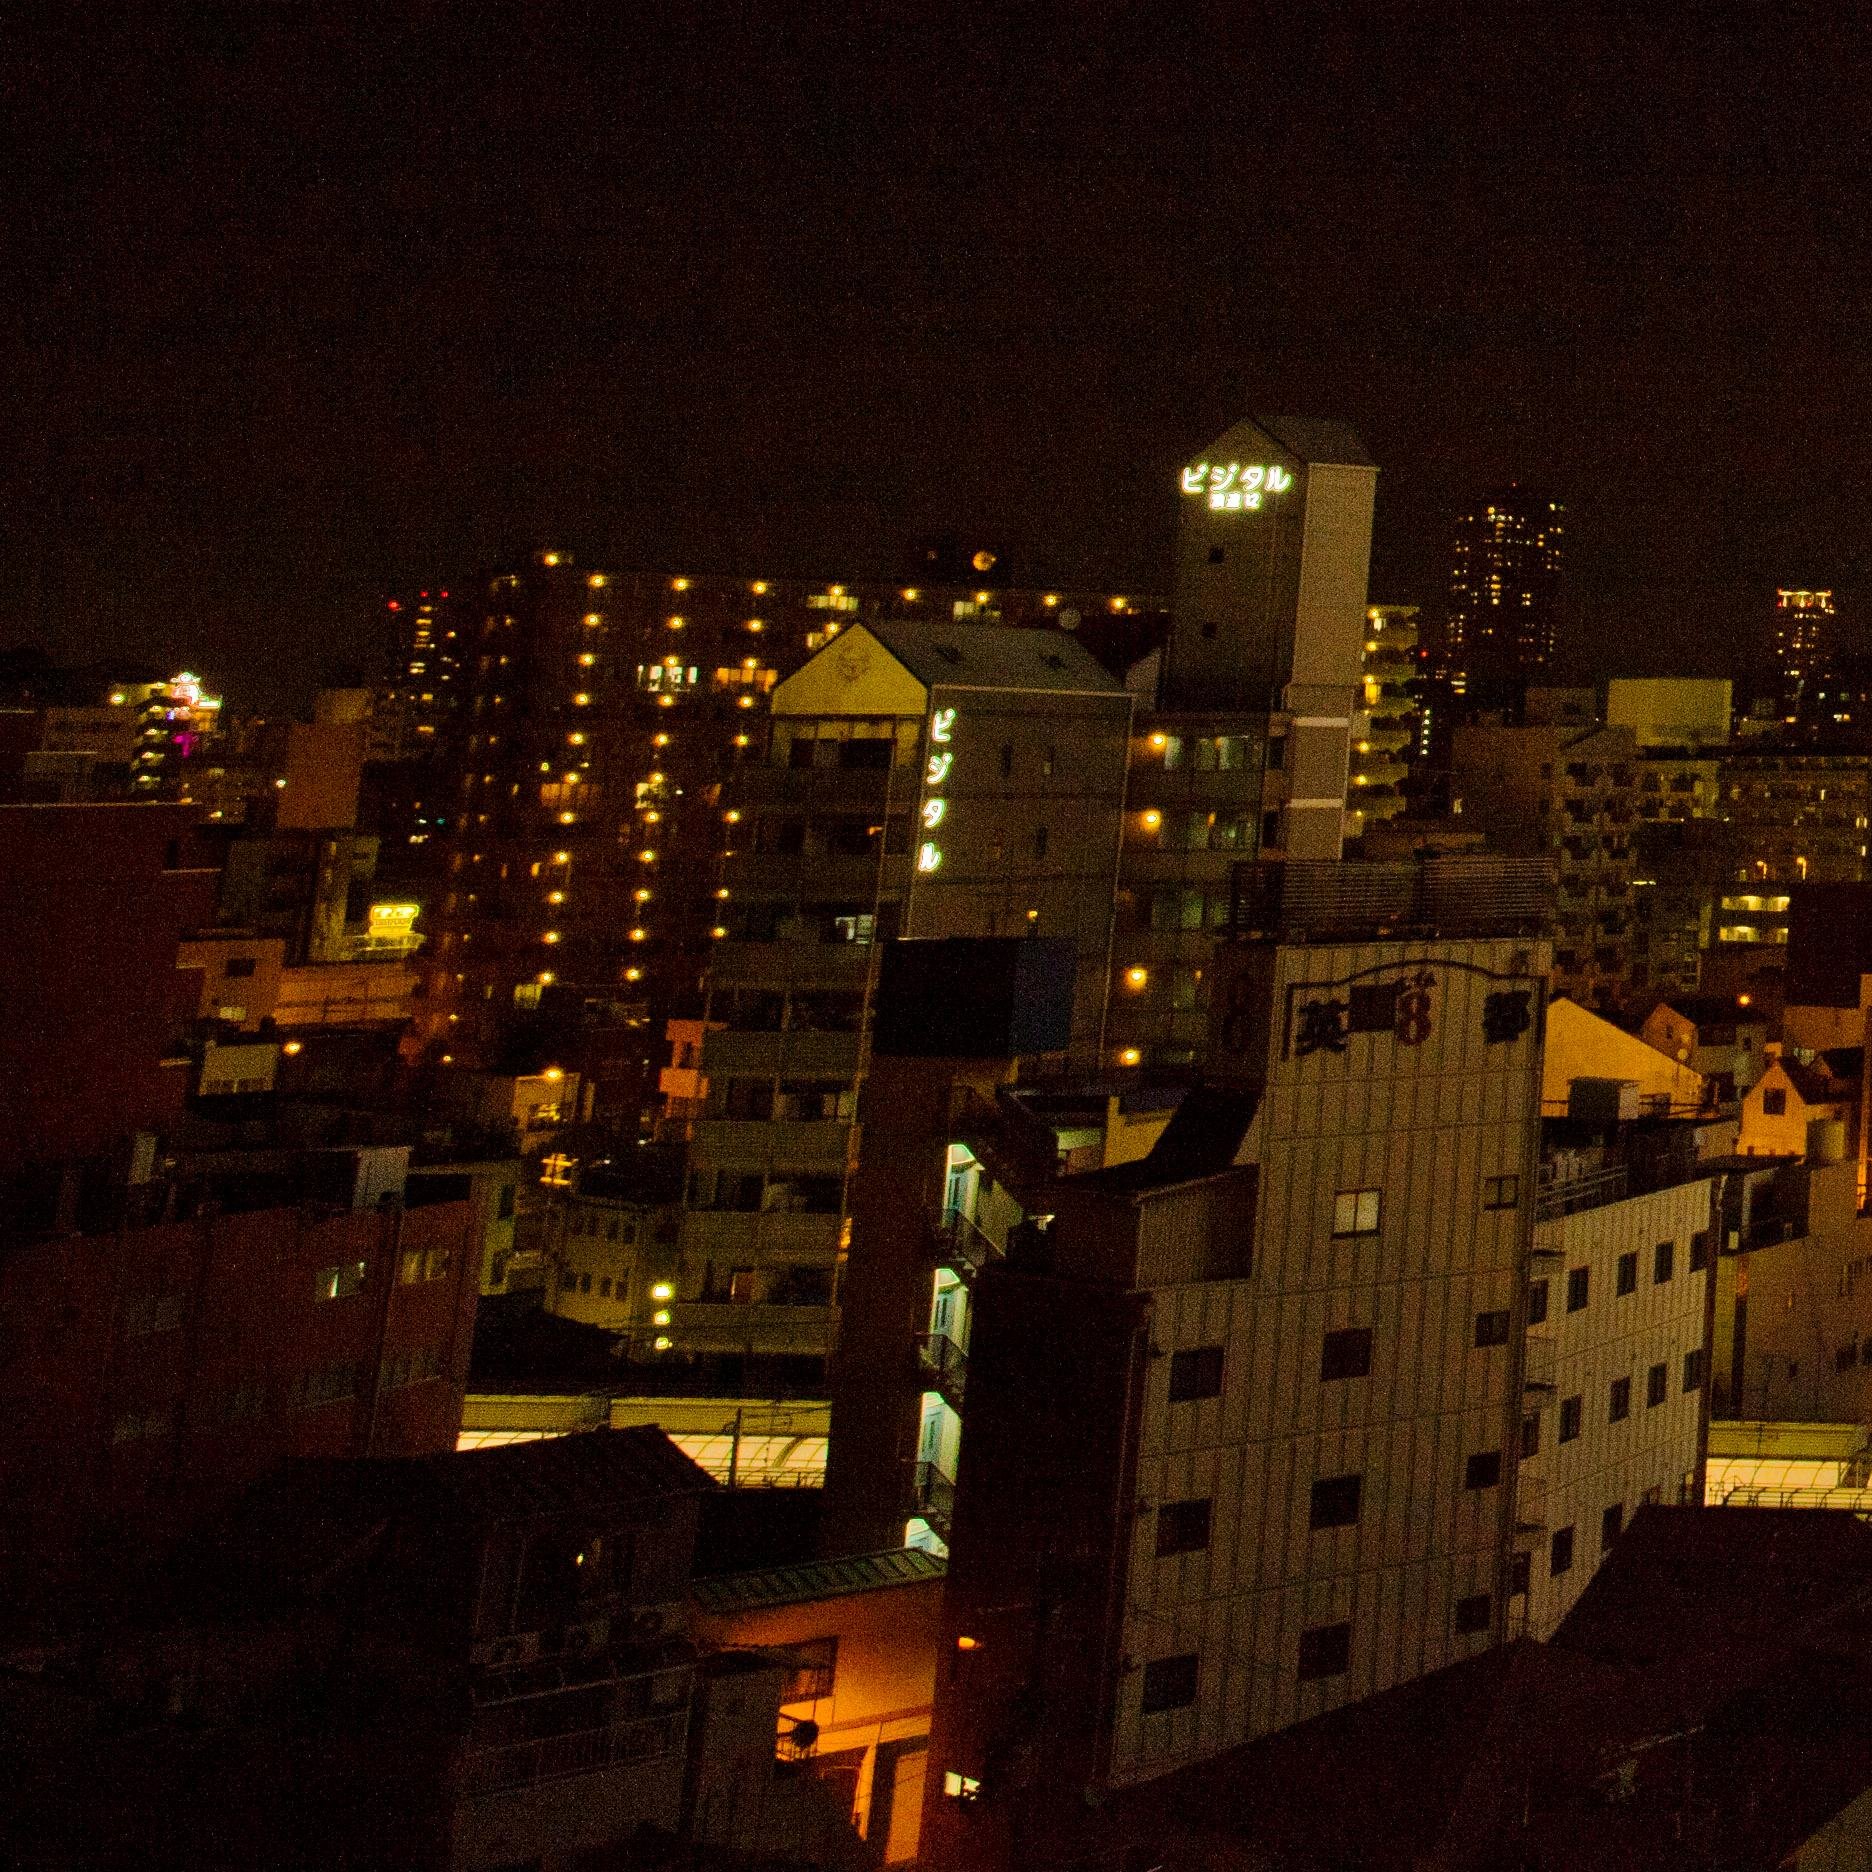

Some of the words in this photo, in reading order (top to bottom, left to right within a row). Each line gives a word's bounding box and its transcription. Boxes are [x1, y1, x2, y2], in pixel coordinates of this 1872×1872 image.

[1181, 463, 1294, 492] ビジタル
[917, 707, 956, 872] ビジタル
